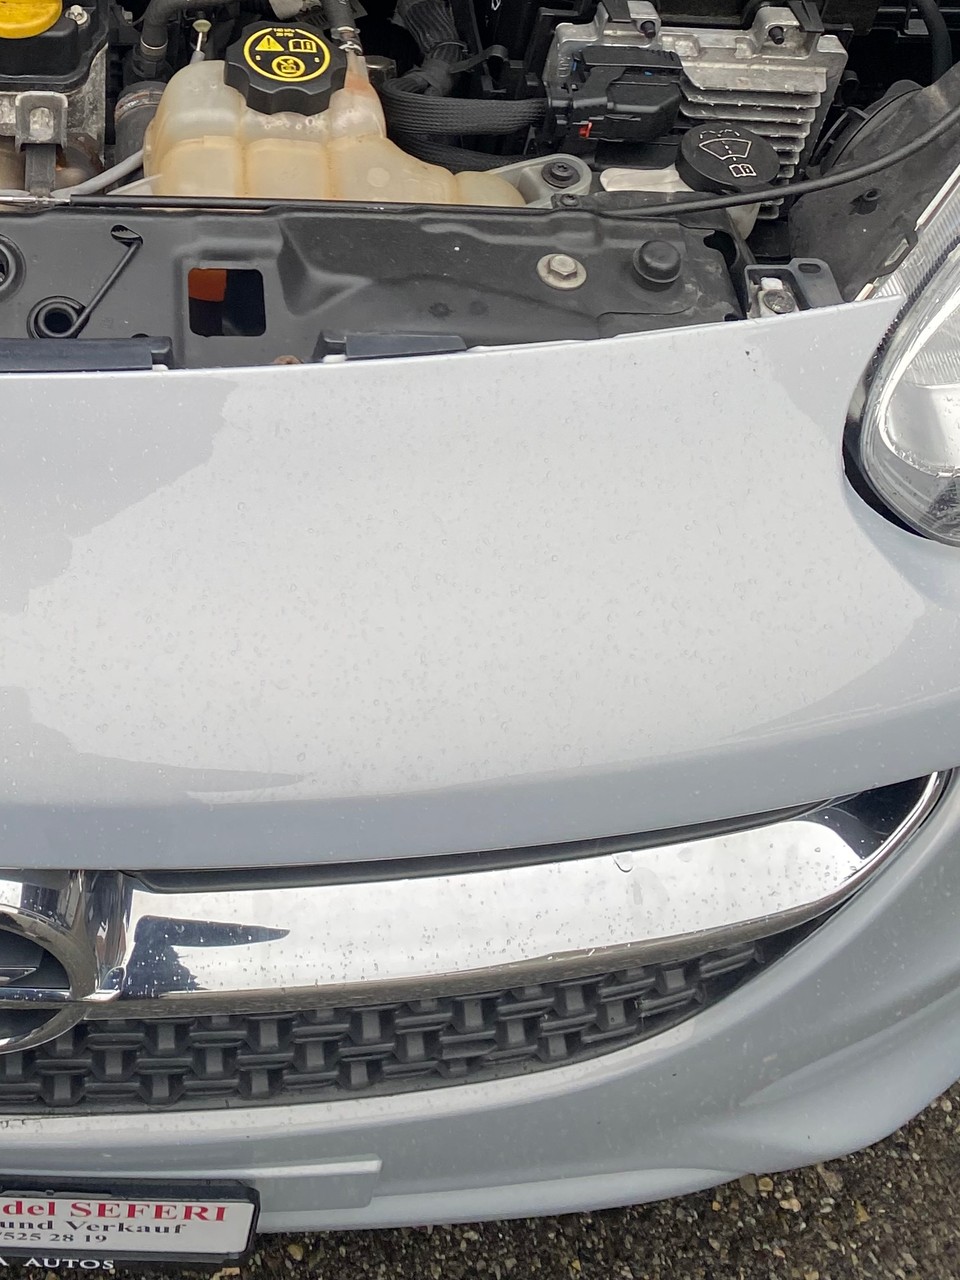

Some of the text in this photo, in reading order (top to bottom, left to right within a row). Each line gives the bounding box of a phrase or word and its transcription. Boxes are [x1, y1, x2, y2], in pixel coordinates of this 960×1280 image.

[70, 1201, 230, 1222] SEFERI
[0, 1219, 54, 1231] und
[66, 1220, 187, 1235] Verkauf
[49, 1233, 75, 1243] 28
[85, 1234, 108, 1244] 19
[22, 1257, 115, 1270] AUTOS
